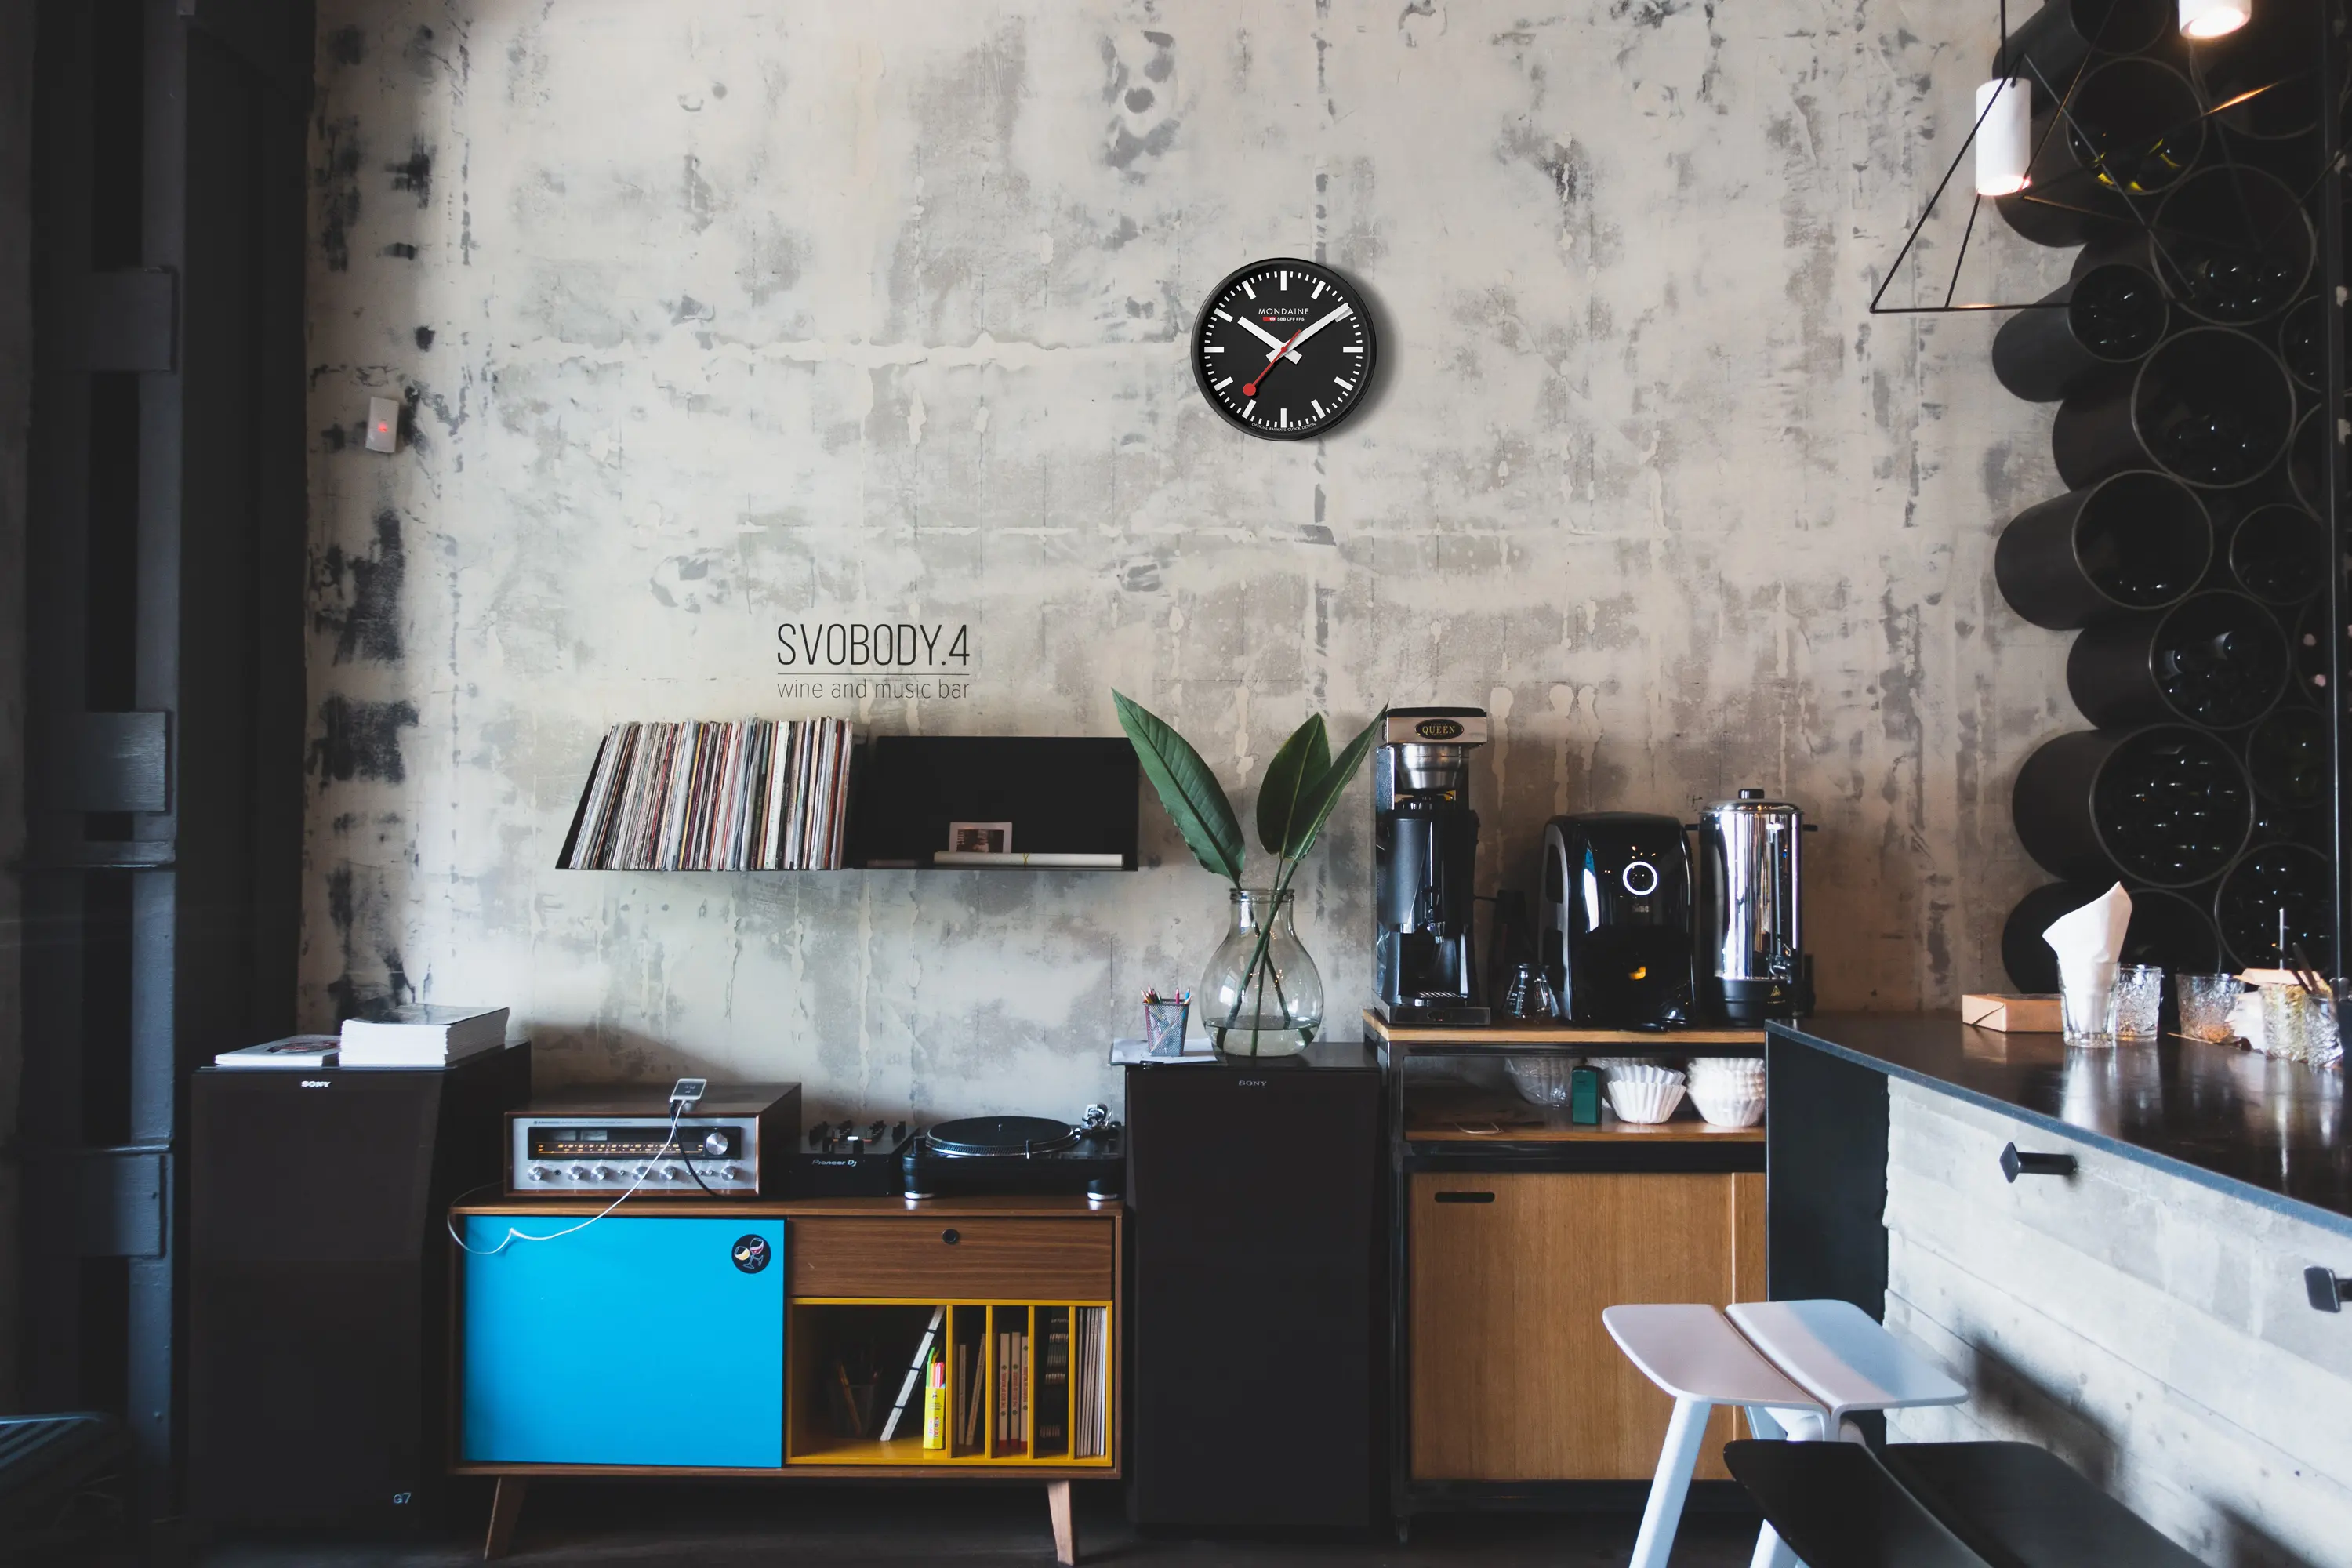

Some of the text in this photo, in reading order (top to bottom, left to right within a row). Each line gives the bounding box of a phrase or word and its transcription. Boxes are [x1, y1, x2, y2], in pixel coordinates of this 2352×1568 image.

[778, 623, 970, 666] SVOBODY.4
[777, 678, 969, 699] wine and music bar
[1421, 726, 1455, 735] QUEEN
[394, 1492, 411, 1504] G7
